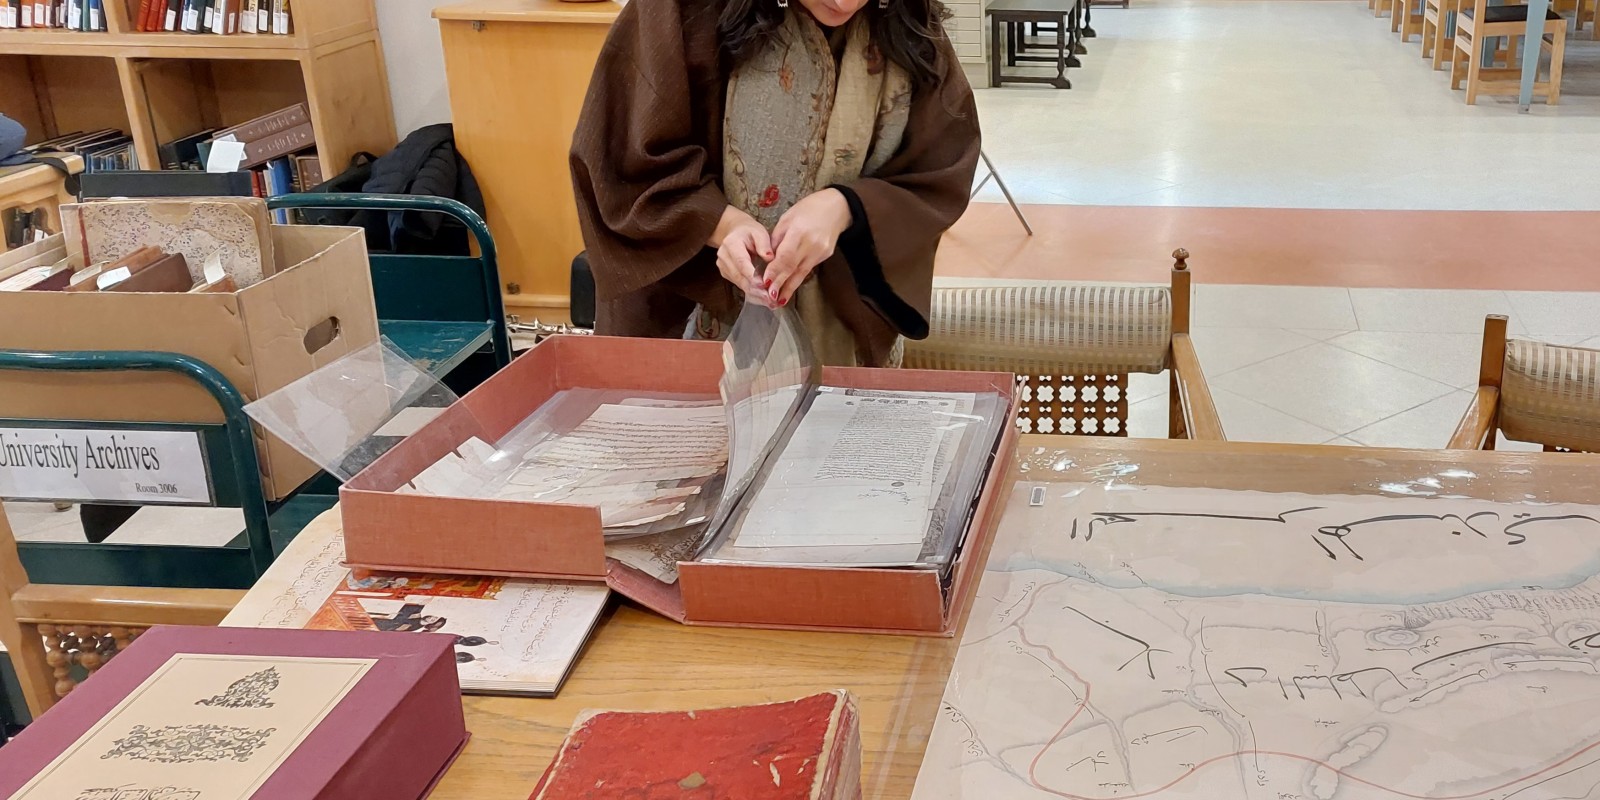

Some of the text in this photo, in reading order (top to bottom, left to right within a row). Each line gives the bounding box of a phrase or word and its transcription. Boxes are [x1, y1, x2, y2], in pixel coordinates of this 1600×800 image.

[0, 432, 160, 478] University Archives
[135, 482, 178, 494] Room 3006
